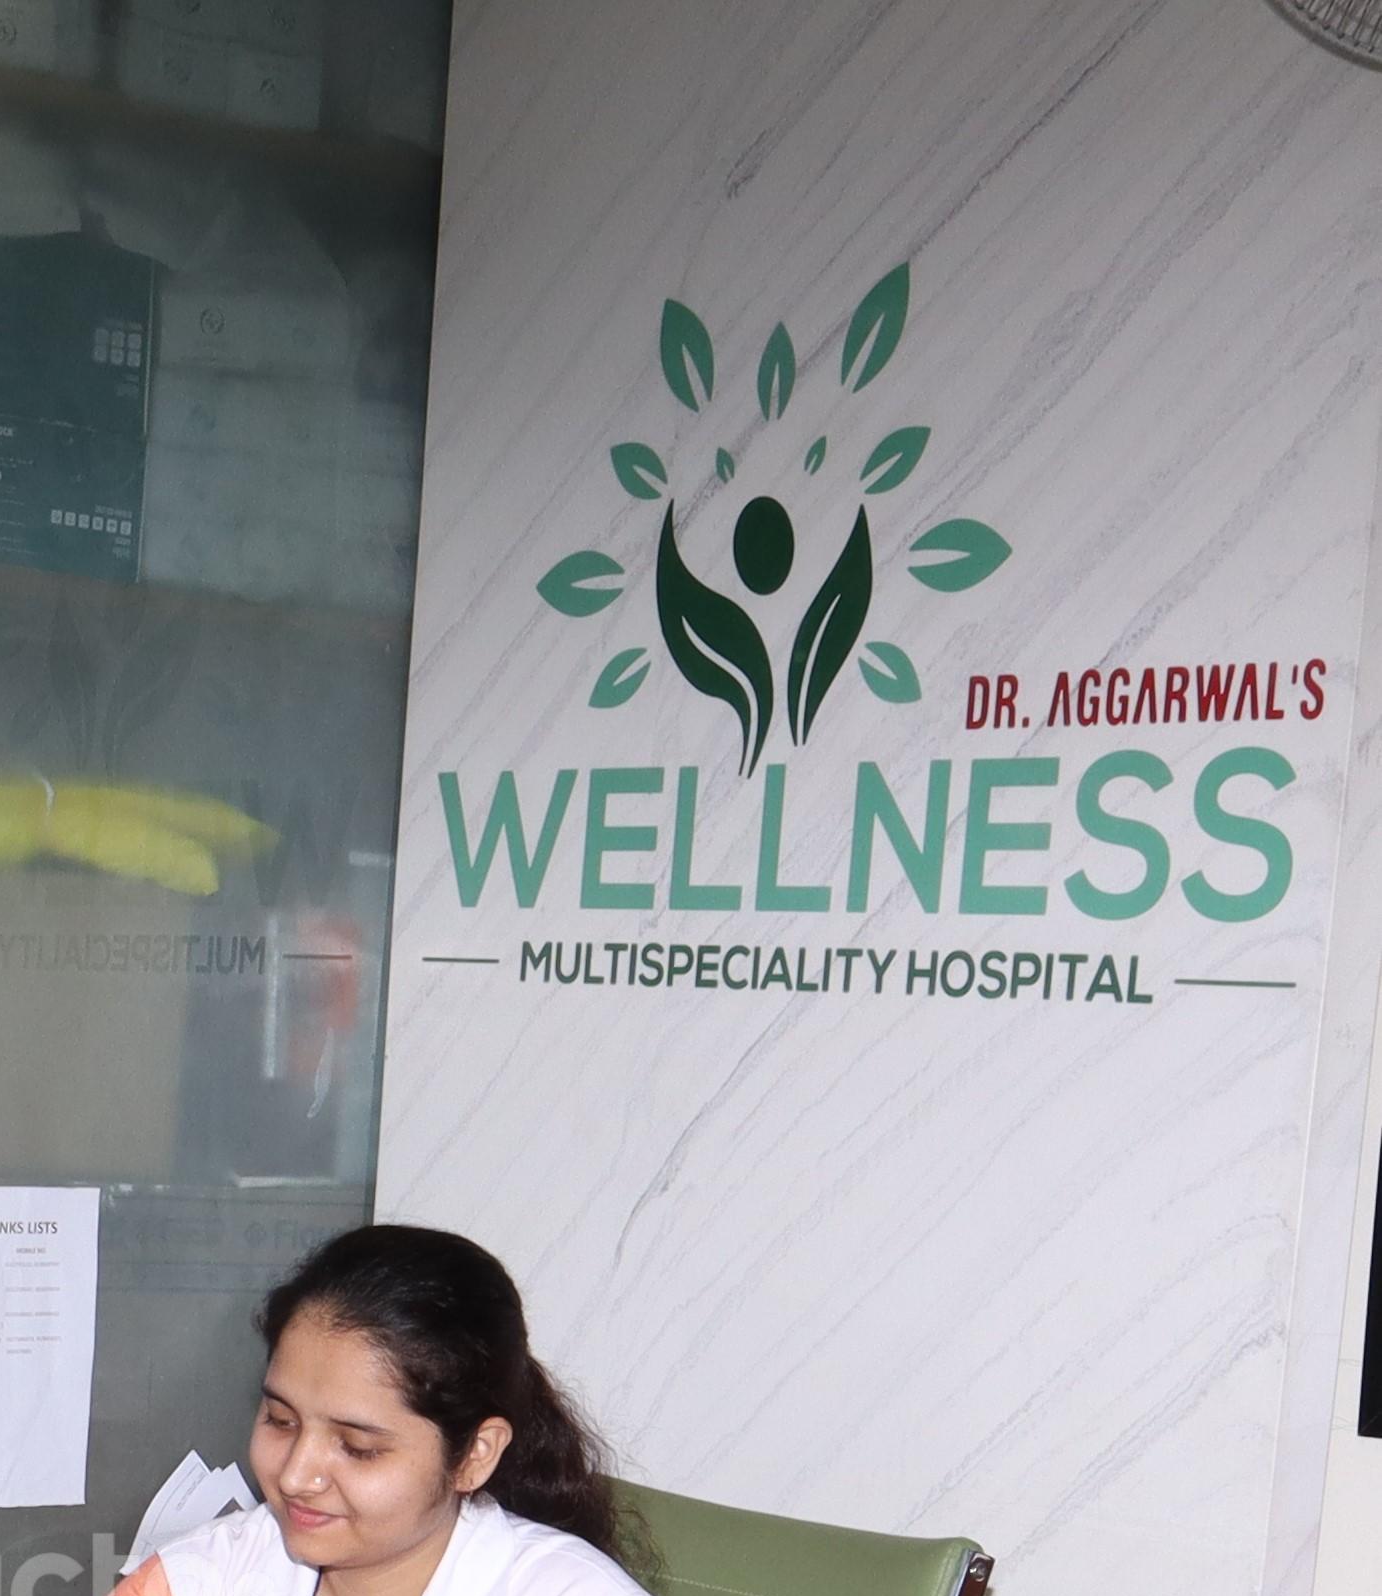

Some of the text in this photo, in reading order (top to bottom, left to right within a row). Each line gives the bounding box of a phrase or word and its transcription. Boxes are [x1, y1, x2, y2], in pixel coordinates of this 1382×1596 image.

[965, 659, 1327, 730] DR. AGGARWAL'S
[438, 746, 1297, 923] WELLNESS
[519, 940, 1154, 1005] MULTISPECIALITY HOSPITAL
[27, 1221, 58, 1234] LISTS
